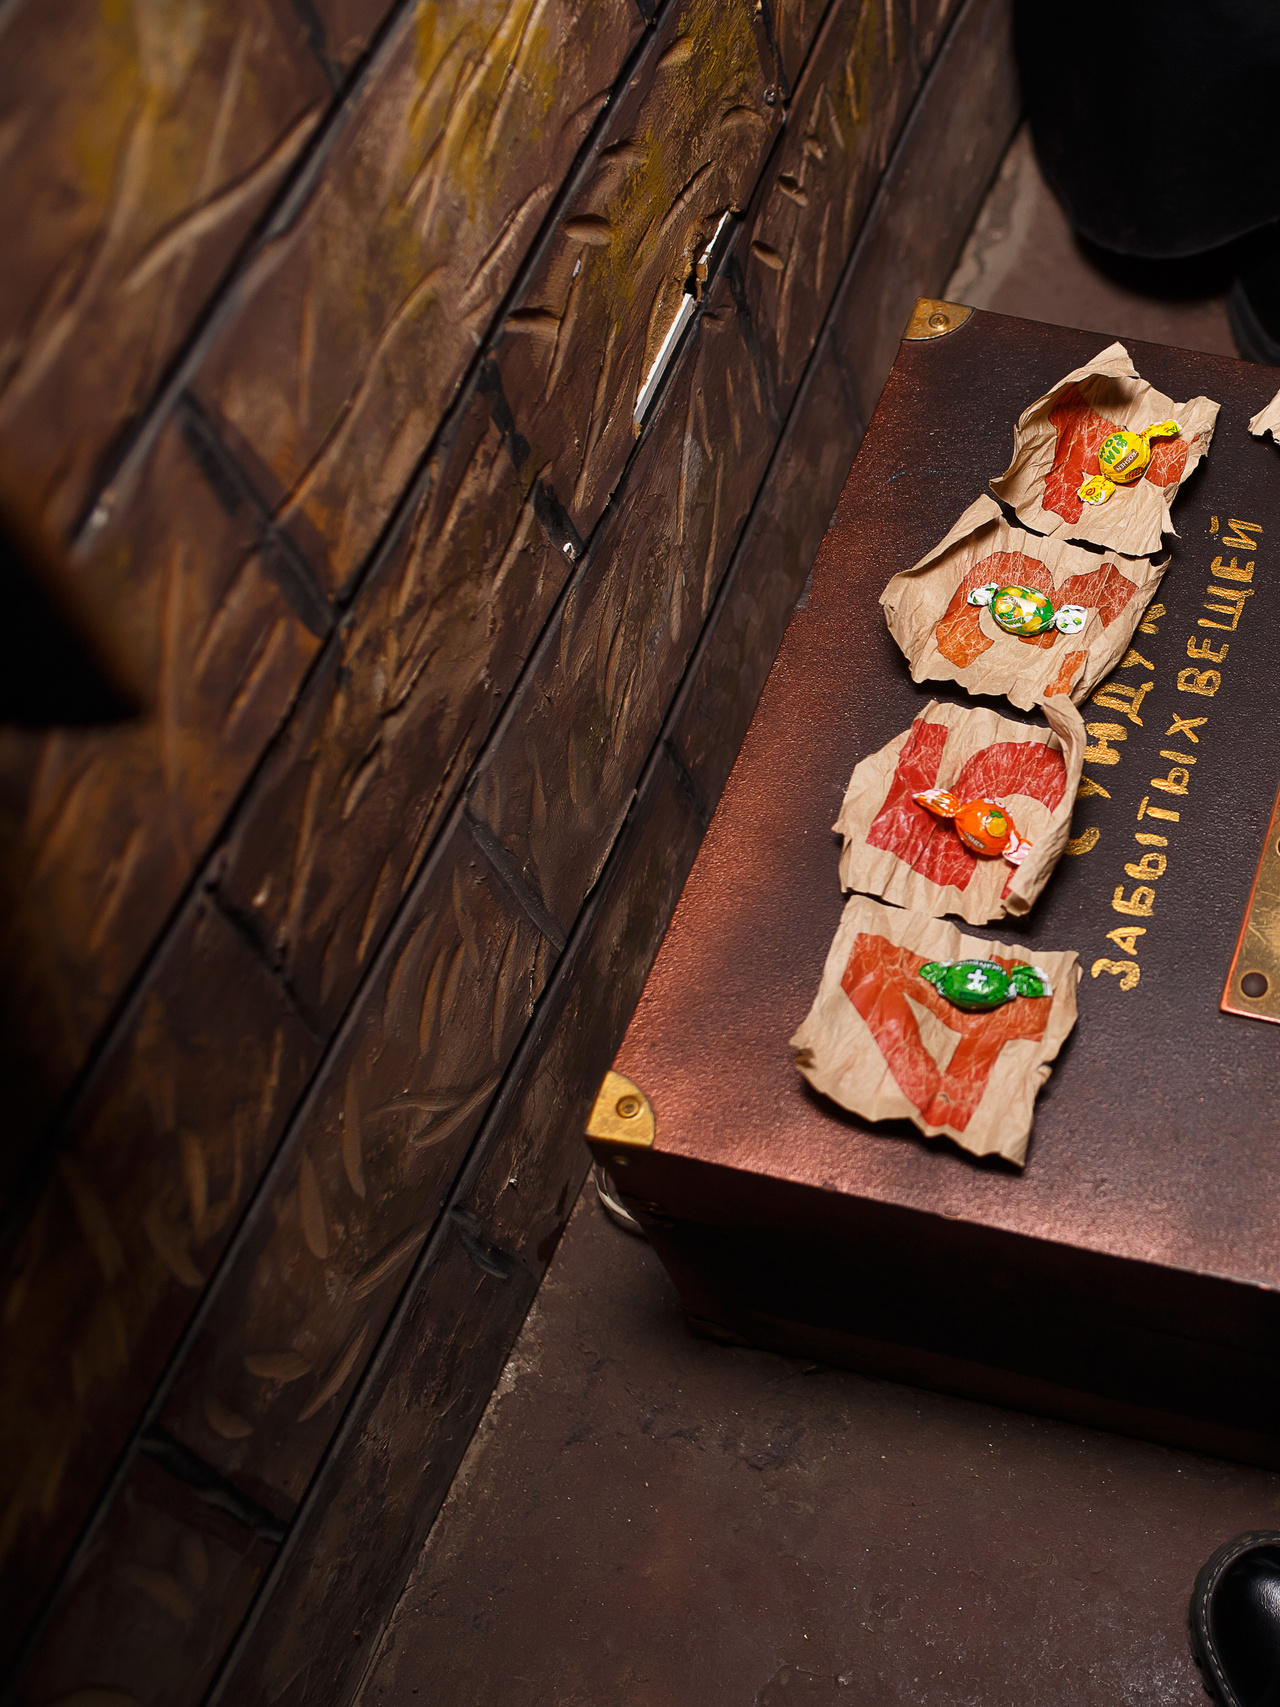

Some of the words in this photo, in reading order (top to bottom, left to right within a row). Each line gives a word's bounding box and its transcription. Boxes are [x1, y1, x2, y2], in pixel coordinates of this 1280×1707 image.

[1103, 439, 1128, 465] BIM
[1114, 450, 1139, 472] ROSHEN
[1091, 712, 1209, 992] ЗАБЫТЫХ
[1177, 515, 1264, 698] ВЕЩЕЙ
[841, 932, 1054, 1133] 4
